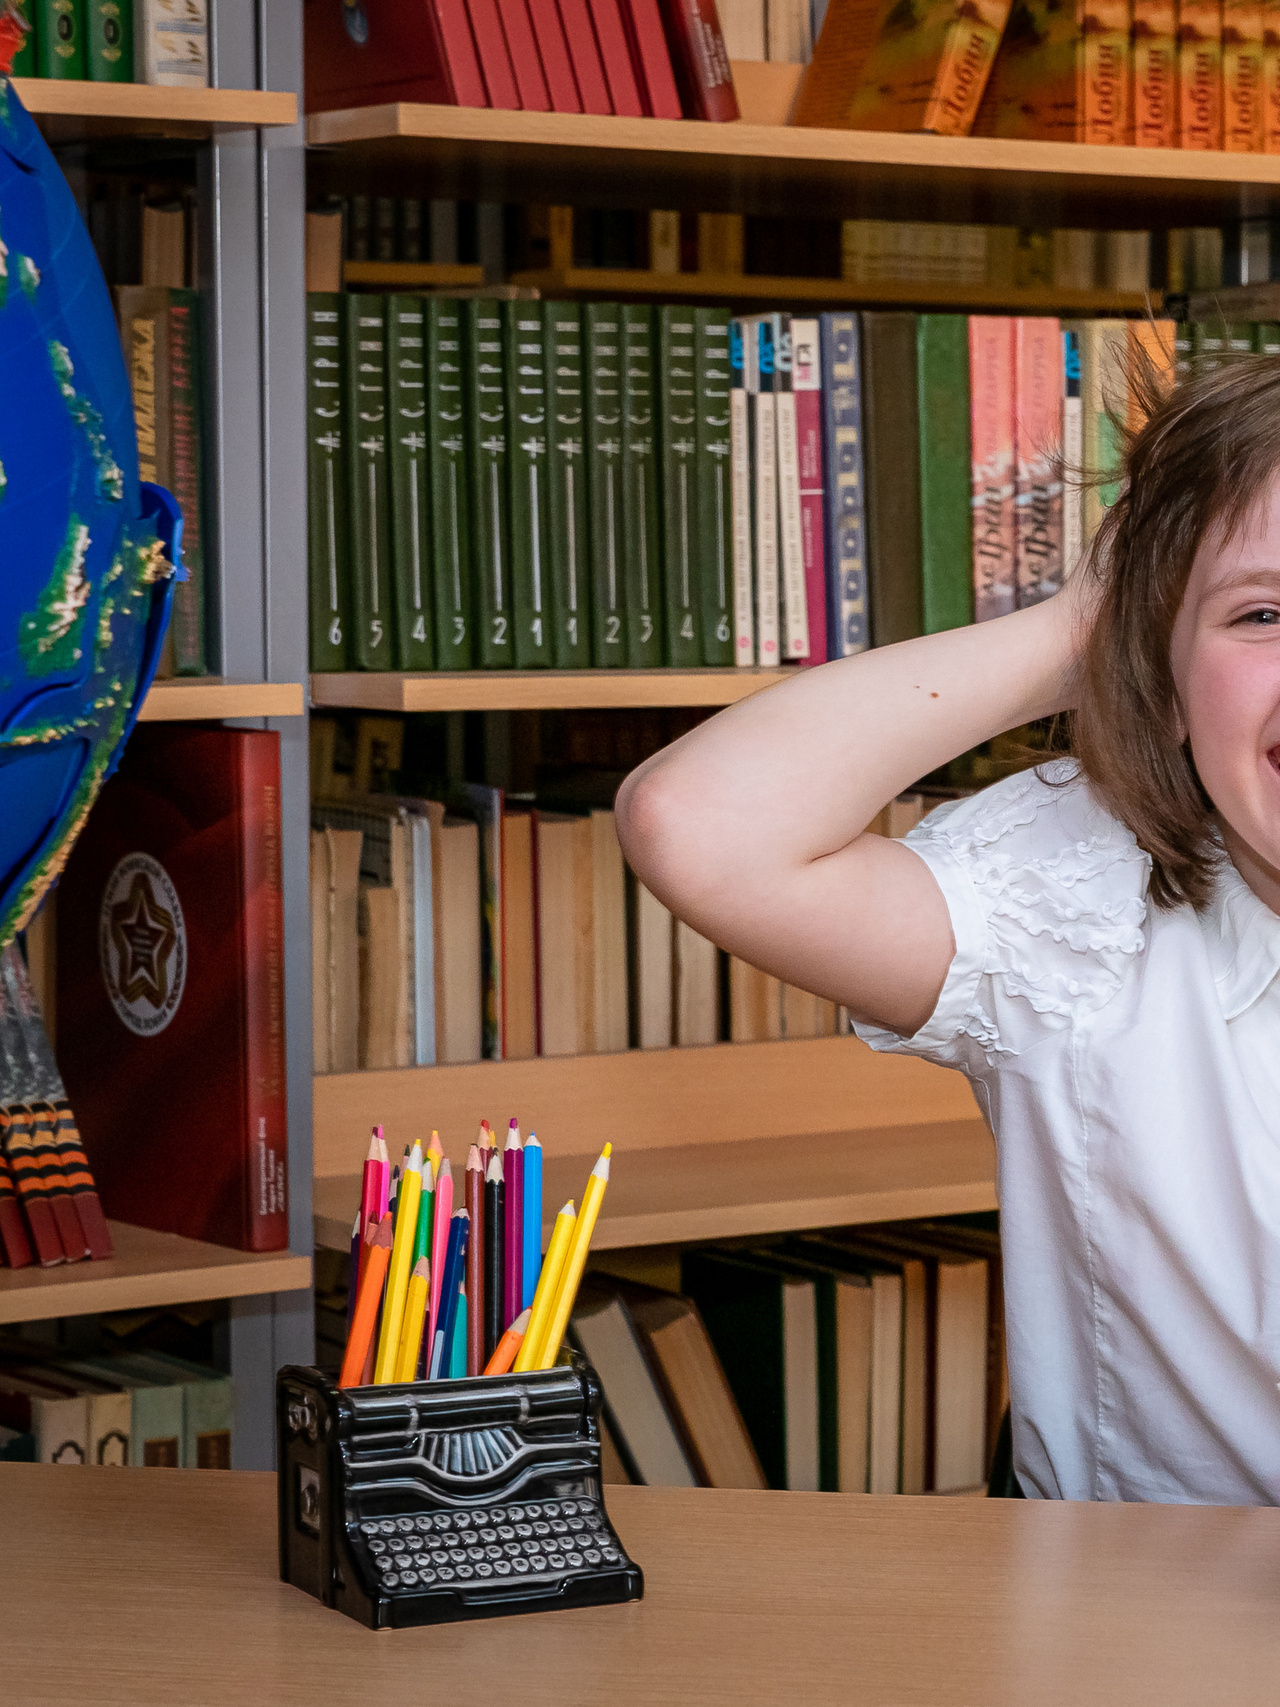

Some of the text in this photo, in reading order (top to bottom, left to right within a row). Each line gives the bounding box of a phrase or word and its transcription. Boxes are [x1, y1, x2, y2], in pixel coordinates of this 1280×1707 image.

[313, 311, 339, 387] ГРИН
[359, 317, 383, 391] ГРИН
[399, 313, 423, 388] ГРИН
[438, 317, 460, 390] ГРИН
[477, 318, 502, 392] ГРИН
[518, 320, 543, 394] ГРИН
[556, 322, 580, 395] ГРИН
[595, 322, 618, 395] ГРИН
[626, 323, 650, 395] ГРИН
[670, 323, 693, 396] ГРИН
[705, 325, 729, 397] ГРИН
[329, 617, 342, 645] 6
[370, 619, 383, 648] 5
[413, 615, 426, 642] 4
[453, 617, 465, 645] 3
[493, 617, 507, 644] 2
[531, 617, 542, 646] 1
[569, 618, 577, 645] 1
[606, 617, 620, 643] 2
[640, 615, 652, 643] 3
[680, 613, 694, 639] 4
[716, 615, 729, 641] 6
